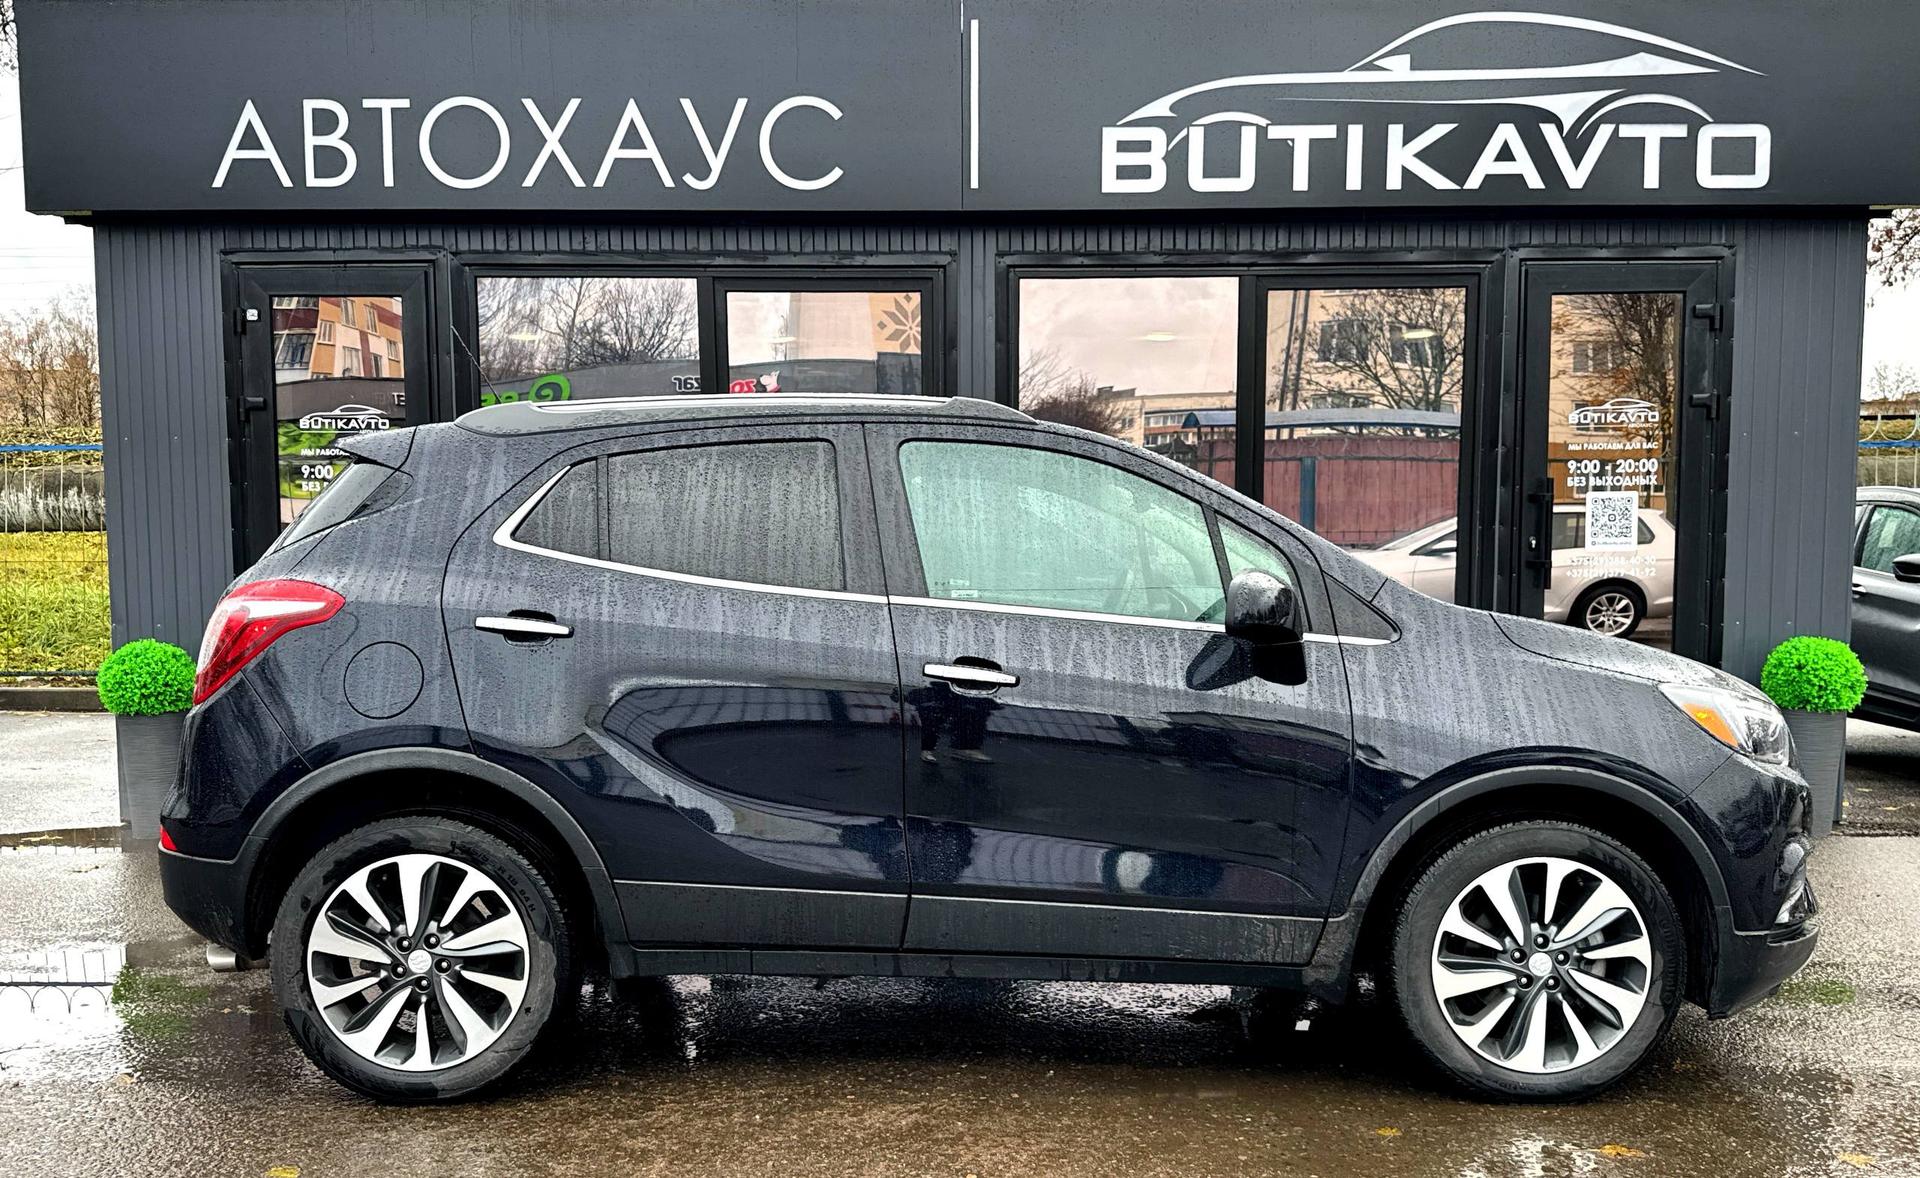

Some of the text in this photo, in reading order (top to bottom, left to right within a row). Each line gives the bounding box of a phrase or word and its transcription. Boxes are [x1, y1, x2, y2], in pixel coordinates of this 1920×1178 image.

[211, 95, 844, 190] АВТОХАУС
[1101, 123, 1771, 193] BUTIKAVTO
[299, 418, 389, 429] BUTIKAVTO
[1568, 411, 1659, 424] BUTIKAVTO
[301, 448, 350, 456] МЫ РАБОТА
[1568, 441, 1658, 451] МЫ РАБОТАЕМ ДЛЯ ВАС
[301, 464, 334, 479] 9:00
[1567, 459, 1600, 474] 9:00
[1616, 458, 1659, 473] 20:00
[301, 481, 320, 492] БЕЗ
[1567, 474, 1658, 487] БЕЗ ВЫХОДНЫХ
